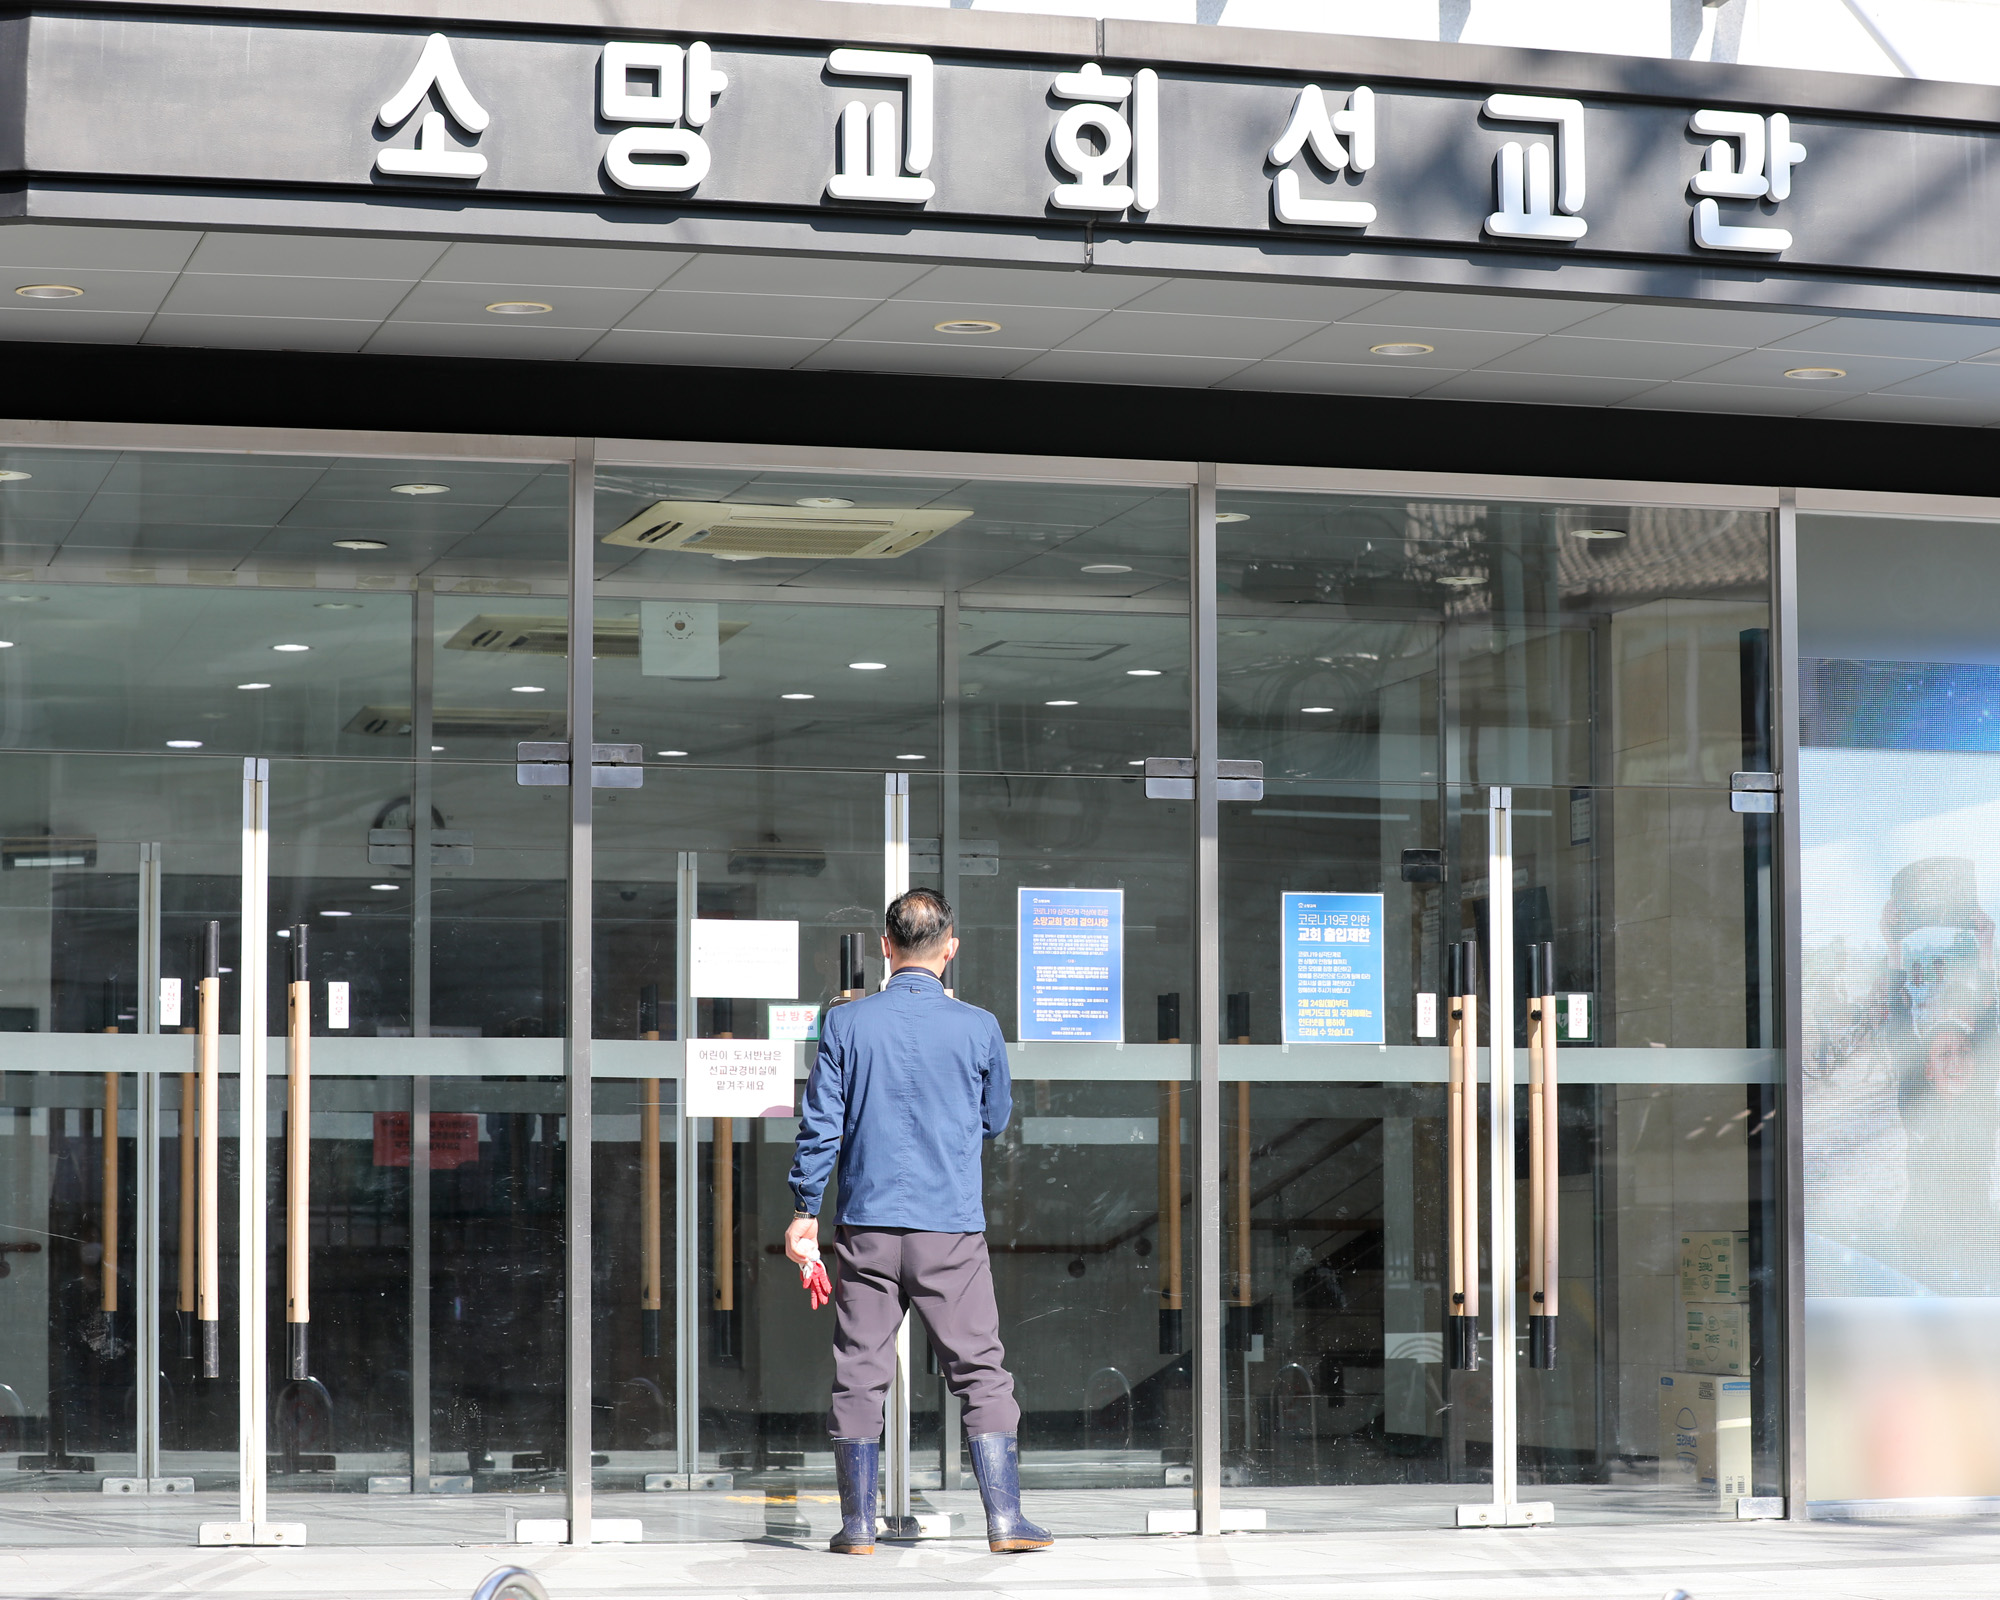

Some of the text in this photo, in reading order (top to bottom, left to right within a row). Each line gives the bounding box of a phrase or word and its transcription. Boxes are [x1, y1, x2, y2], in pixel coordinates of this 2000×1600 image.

[1033, 916, 1108, 927] 소망교회 당회 결의사항
[1298, 914, 1370, 926] 코로나19로 인한
[1298, 927, 1371, 942] 교회 출입제한
[1298, 999, 1348, 1008] 2월 24일(월)부터
[1298, 1028, 1354, 1036] 드리실 수 있습니다
[699, 1050, 782, 1060] 어린이 도서반납은
[709, 1066, 777, 1076] 선교관경비실에
[716, 1080, 764, 1090] 맡겨주세요
